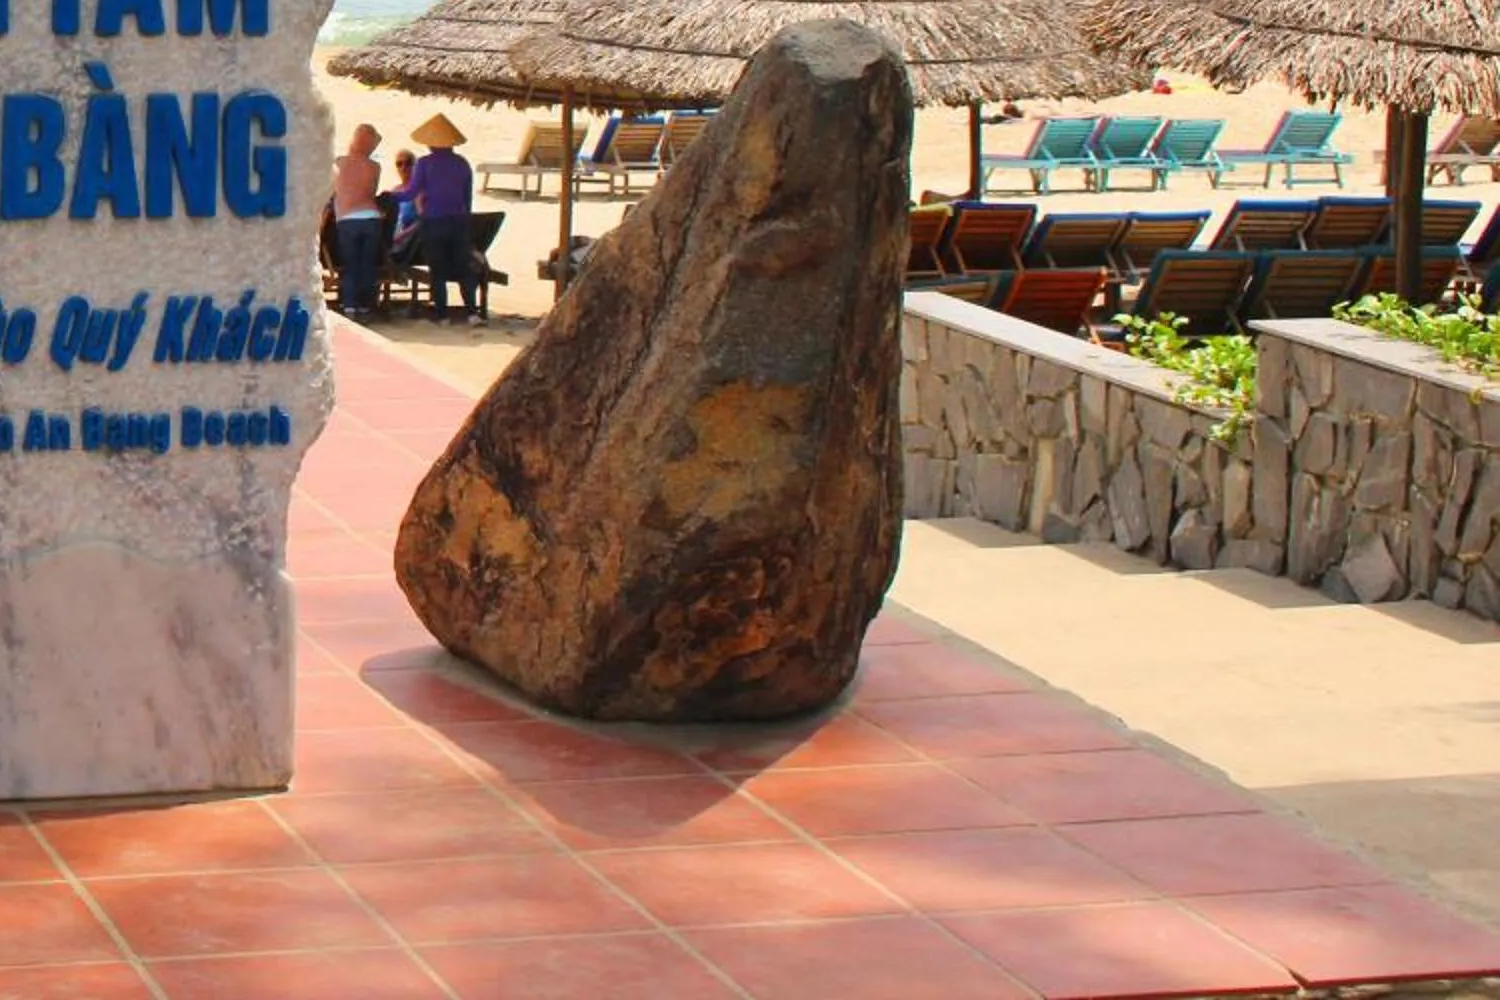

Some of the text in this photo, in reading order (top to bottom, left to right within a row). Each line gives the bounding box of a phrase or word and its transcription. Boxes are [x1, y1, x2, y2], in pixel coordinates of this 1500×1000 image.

[49, 290, 148, 372] Quý
[153, 288, 310, 363] Khách
[22, 407, 71, 453] An
[82, 406, 171, 455] Bang
[181, 404, 291, 446] Beach
